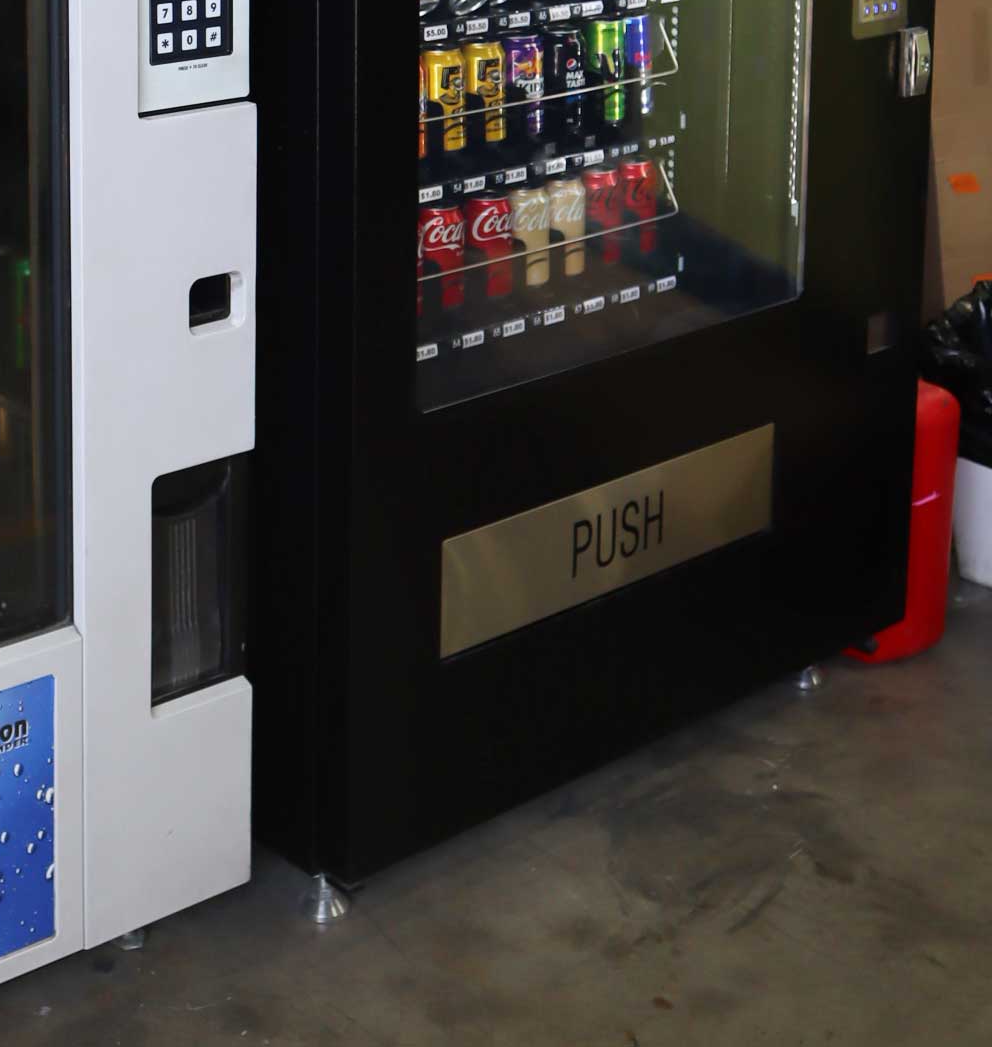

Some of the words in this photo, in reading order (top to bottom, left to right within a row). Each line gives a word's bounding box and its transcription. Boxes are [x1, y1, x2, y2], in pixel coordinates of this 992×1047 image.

[186, 5, 192, 16] 8
[210, 2, 216, 12] 9
[162, 8, 168, 18] 7
[499, 18, 508, 26] 45
[510, 16, 528, 24] $5.50
[456, 24, 464, 32] 44
[468, 22, 488, 32] $5.50
[210, 32, 217, 42] #
[426, 28, 446, 38] $5.00
[186, 34, 193, 45] 0
[566, 71, 584, 80] MAX
[496, 174, 504, 184] 55
[454, 184, 462, 192] 54
[421, 190, 441, 200] $1.80
[504, 322, 524, 334] $1.80
[464, 334, 484, 346] $1.80
[570, 489, 665, 580] PUSH
